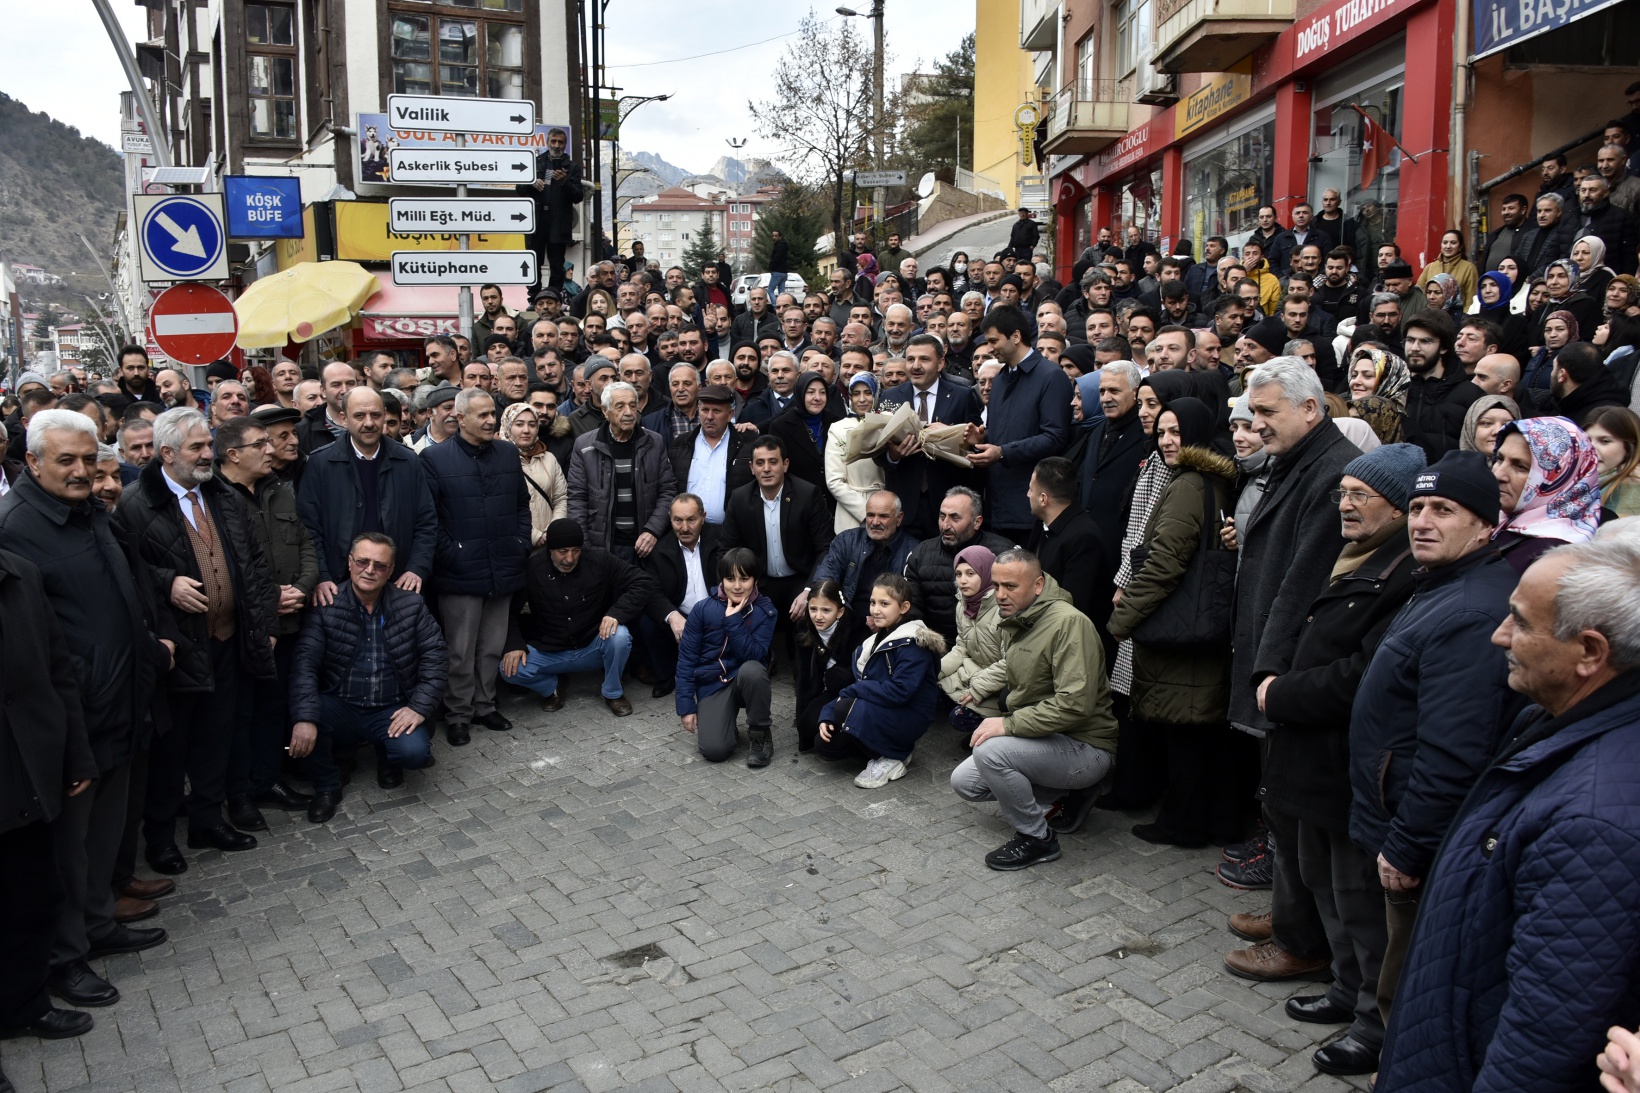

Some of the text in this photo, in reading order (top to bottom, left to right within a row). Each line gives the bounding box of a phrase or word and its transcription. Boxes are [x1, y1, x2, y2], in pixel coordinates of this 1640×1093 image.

[1492, 0, 1590, 42] İL BAŞ
[1296, 0, 1395, 58] DOĞUŞ TUHAF
[1186, 79, 1234, 122] kitaphane
[396, 107, 450, 121] Valilik
[442, 132, 547, 147] AVARYUM
[397, 160, 498, 174] Askerlik Şubesi
[246, 192, 282, 209] KÖŞK
[247, 207, 283, 222] BÜFE
[397, 210, 495, 225] Milli Eğt. Müd.
[398, 261, 489, 277] Kütüphane
